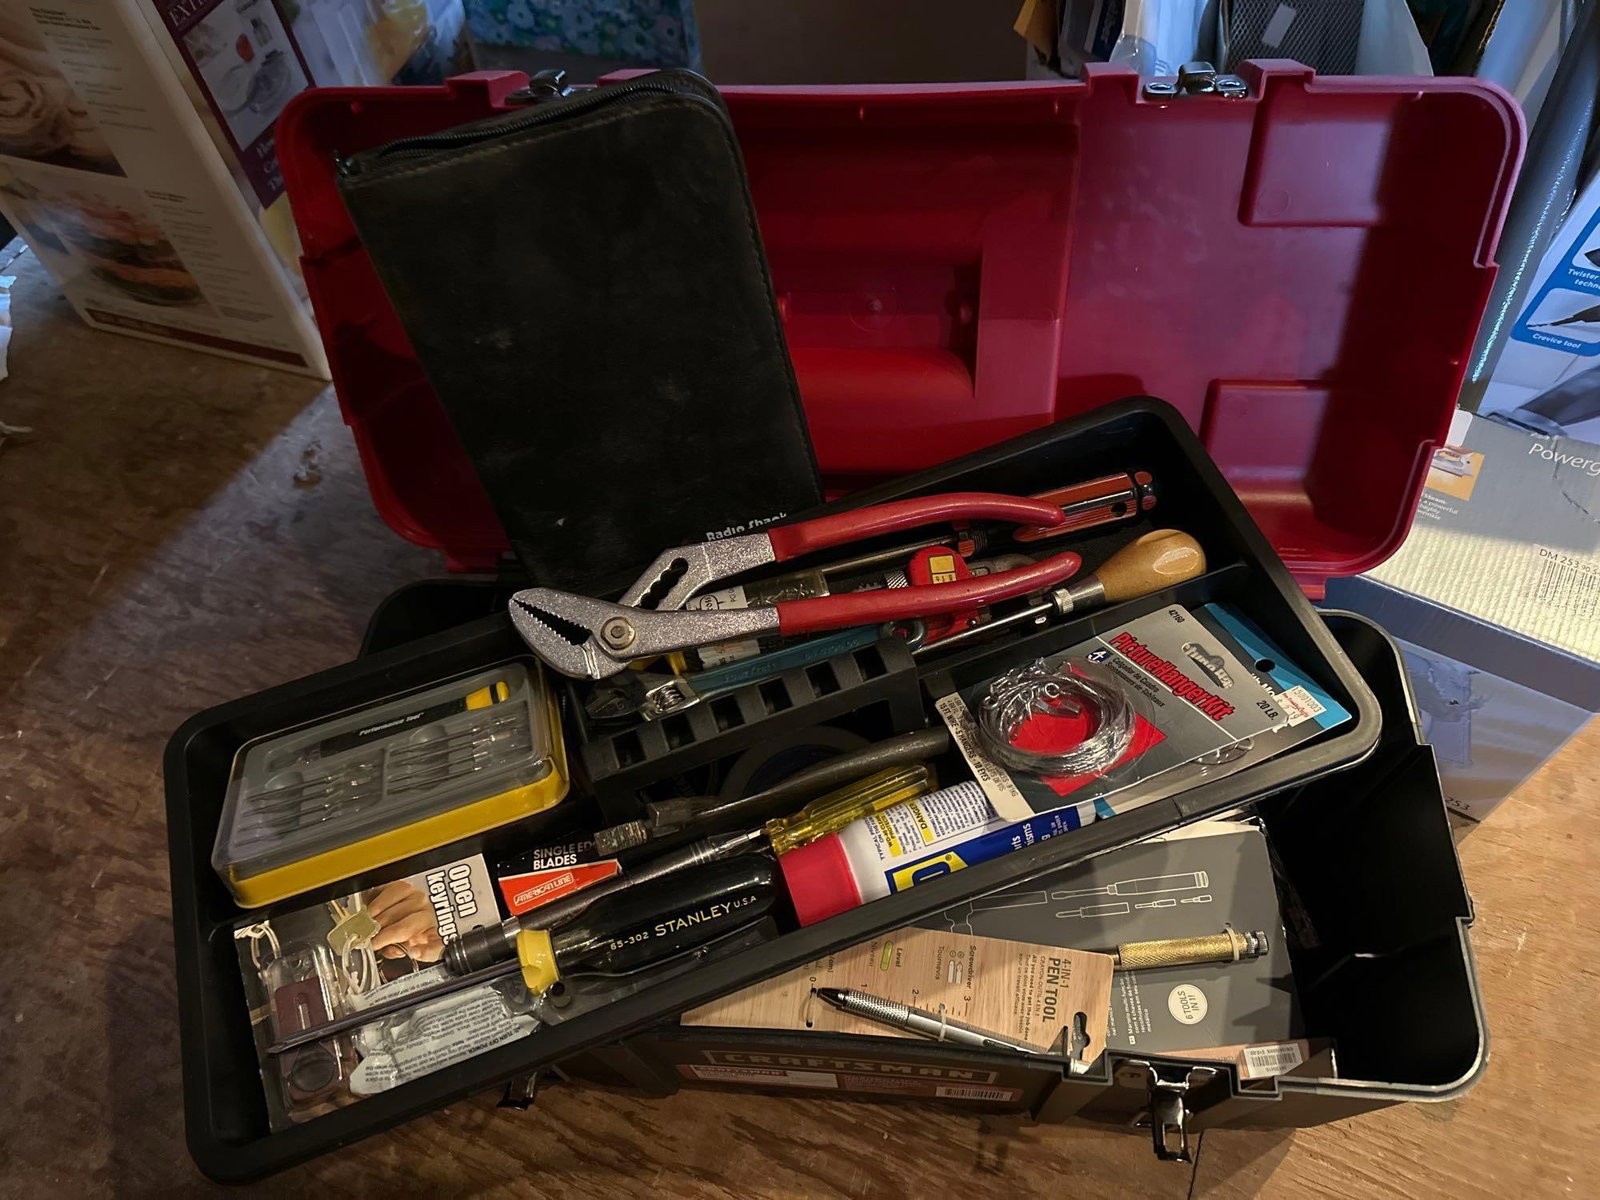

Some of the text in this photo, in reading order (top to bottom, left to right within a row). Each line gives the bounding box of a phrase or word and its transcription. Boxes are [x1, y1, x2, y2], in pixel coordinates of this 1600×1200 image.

[1532, 333, 1581, 349] Crevice tool
[706, 525, 745, 541] Radio
[1539, 548, 1558, 560] DM
[1560, 556, 1579, 568] 253
[938, 701, 947, 710] 15
[1255, 697, 1279, 721] 20 LB.
[945, 713, 959, 729] WIRE
[958, 733, 976, 759] HANGERS
[972, 759, 983, 770] 10
[976, 766, 991, 783] EYES
[910, 802, 927, 828] DANGER
[532, 837, 597, 859] SINGLE ED
[871, 835, 885, 860] TYPICAL
[532, 853, 577, 870] BLADES
[445, 864, 481, 918] Open
[654, 902, 733, 937] STANLEY
[867, 940, 878, 968] Niveau
[893, 946, 904, 968] Level
[933, 945, 945, 981] Tournevis
[964, 944, 977, 989] Screwdriver
[1058, 958, 1072, 989] 4-IN-1
[808, 975, 816, 983] 0
[1042, 956, 1061, 1023] PEN TOOL
[962, 994, 971, 1002] 3
[1178, 989, 1191, 1014] TOOLS
[1190, 1001, 1199, 1011] IN
[487, 1037, 499, 1046] OFF
[497, 1030, 514, 1041] TURN
[724, 1054, 974, 1078] CRAFTSMAN
